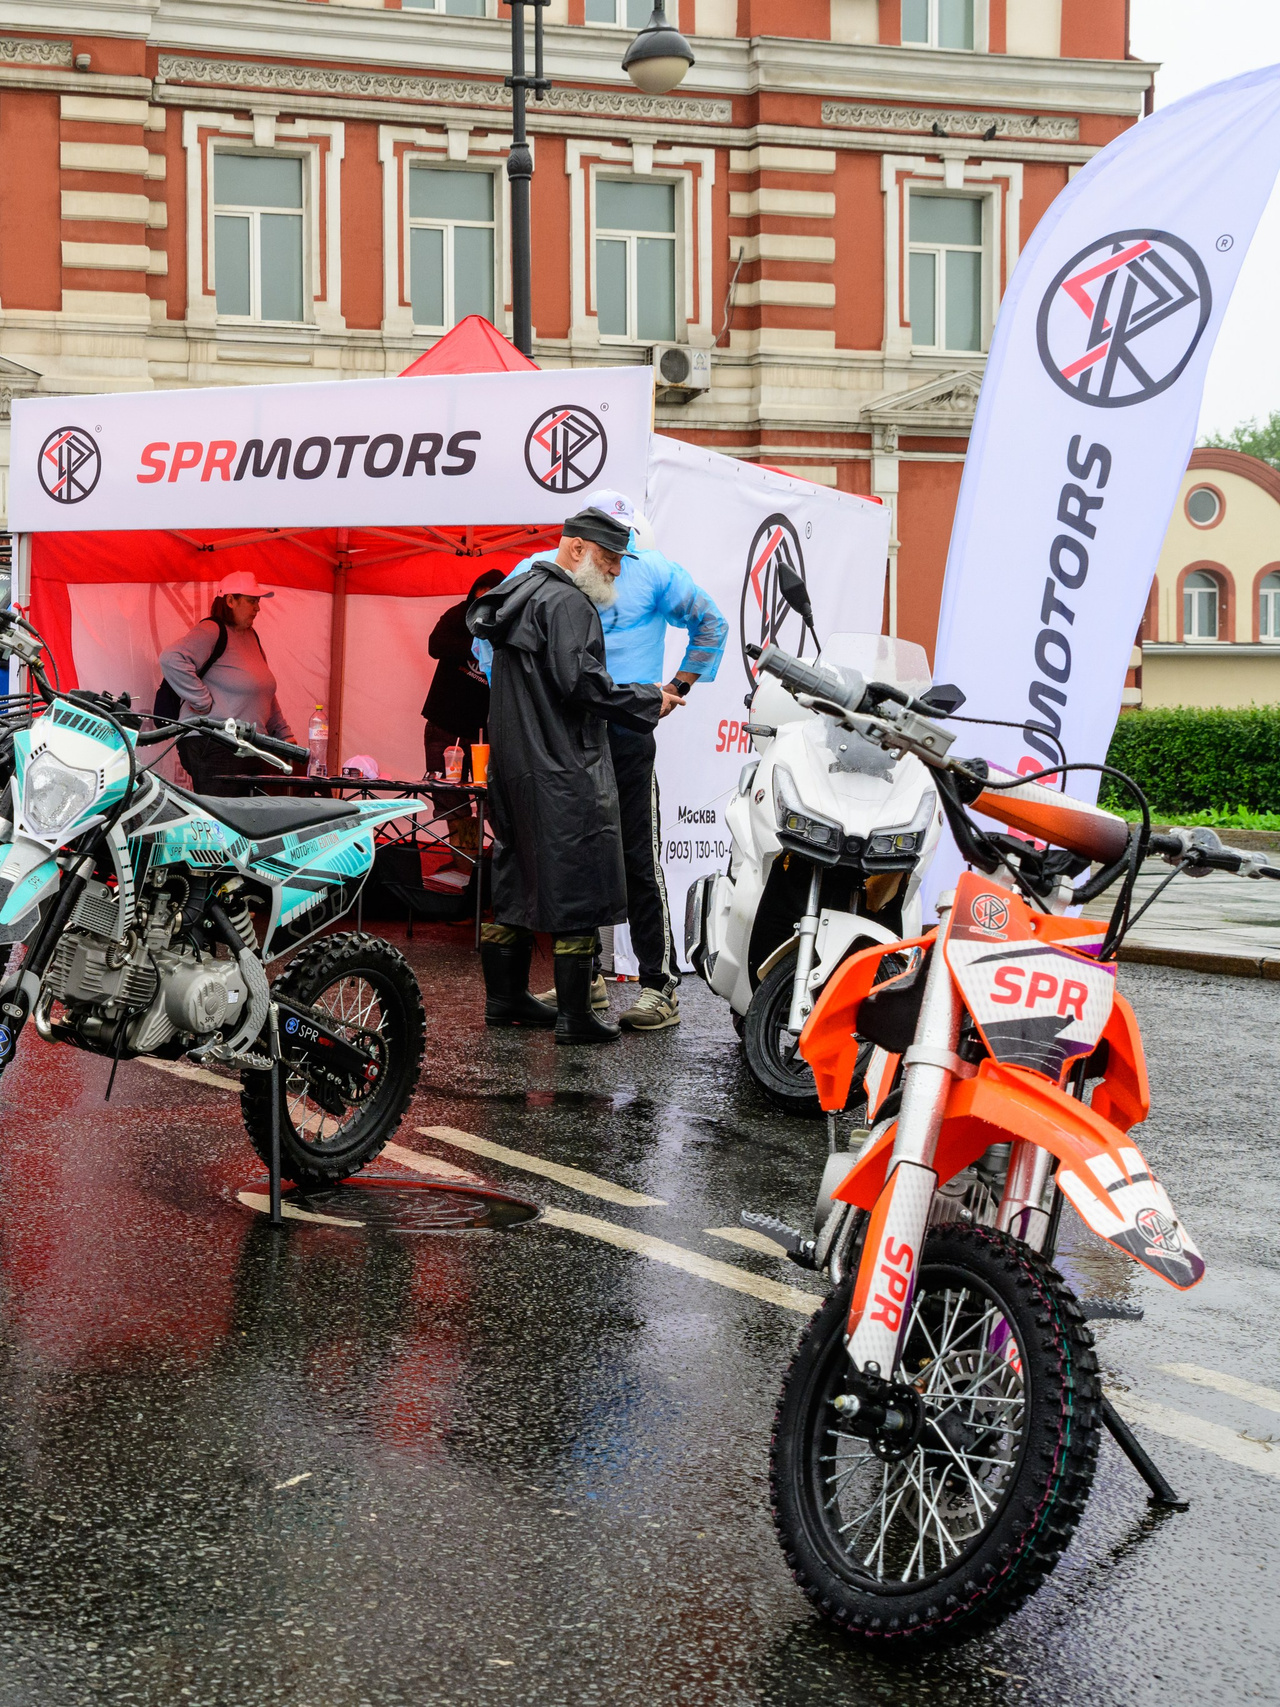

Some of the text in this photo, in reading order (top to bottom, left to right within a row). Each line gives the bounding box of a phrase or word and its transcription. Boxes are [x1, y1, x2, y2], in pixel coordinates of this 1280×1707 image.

[136, 430, 482, 484] SPRMOTORS
[715, 719, 758, 754] SPR
[678, 806, 716, 825] Москва
[190, 821, 214, 841] SPR
[170, 846, 183, 857] SPR
[290, 832, 340, 862] MOTOPRO EDITION
[666, 840, 693, 864] (903)
[990, 965, 1089, 1021] SPR
[204, 1016, 215, 1024] SPR
[298, 1025, 320, 1043] SPR
[870, 1236, 915, 1333] SPR
